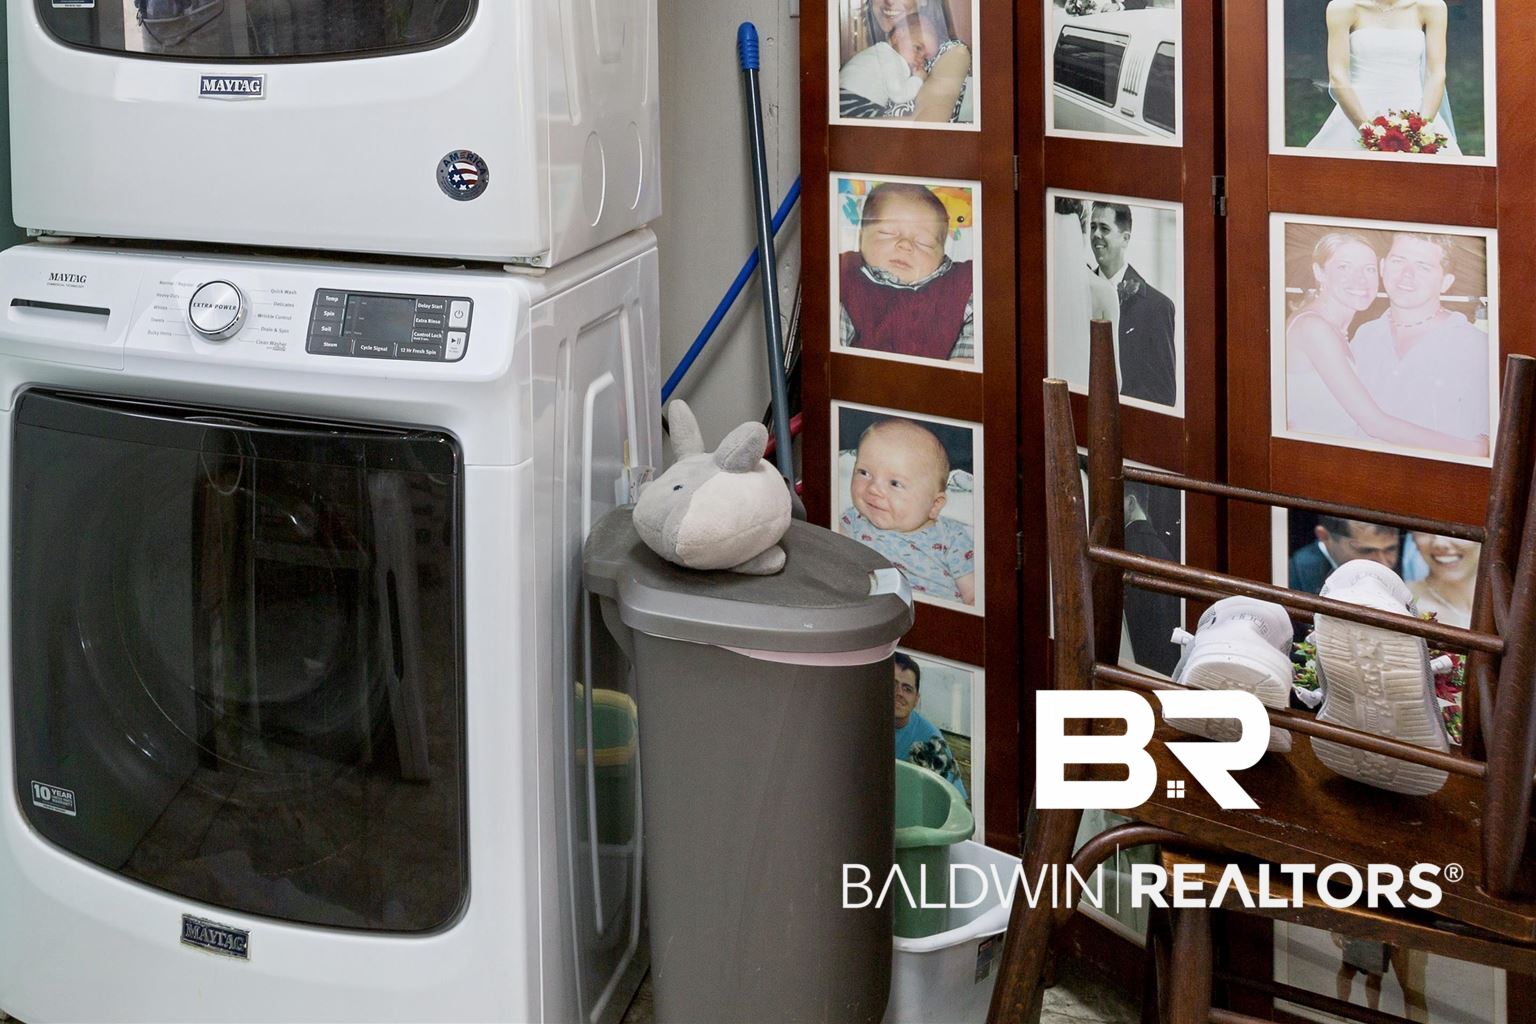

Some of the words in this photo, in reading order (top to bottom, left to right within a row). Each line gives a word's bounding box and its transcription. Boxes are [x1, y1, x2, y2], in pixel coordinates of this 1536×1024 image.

[202, 79, 261, 93] MAYTAG
[443, 152, 487, 176] AMERICA
[48, 272, 87, 284] MAYTAG
[325, 295, 339, 303] Temp
[417, 302, 431, 310] Delay
[34, 784, 51, 801] 10
[51, 788, 73, 800] YEAR
[185, 923, 245, 952] MAYTAG
